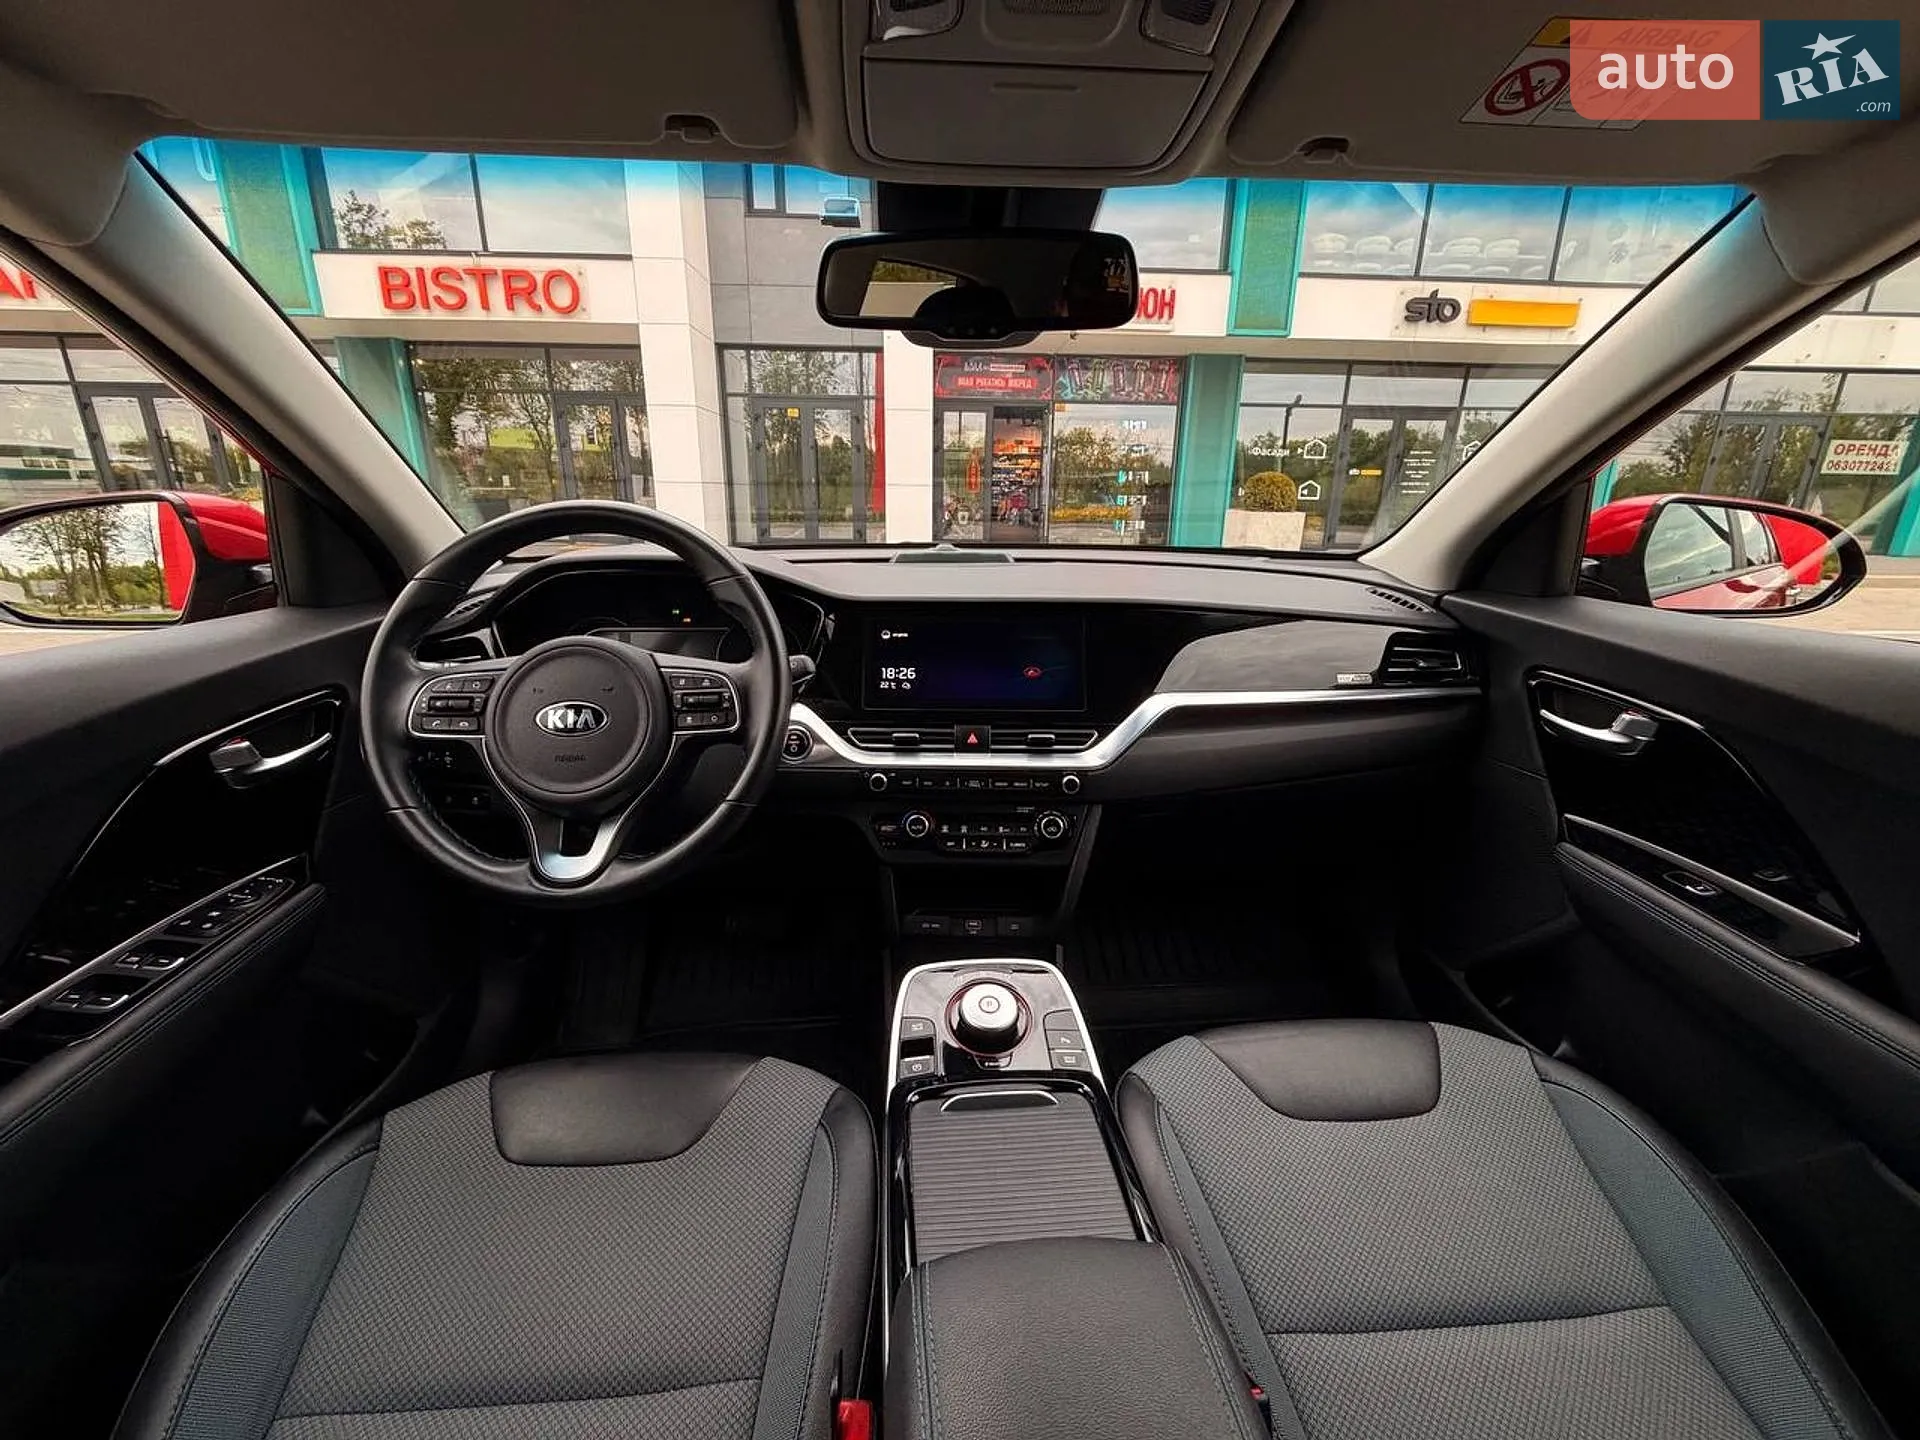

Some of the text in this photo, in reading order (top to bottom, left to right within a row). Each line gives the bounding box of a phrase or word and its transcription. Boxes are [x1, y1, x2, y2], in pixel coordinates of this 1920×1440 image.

[378, 266, 580, 314] BISTRO
[1404, 288, 1462, 323] sto
[1252, 446, 1290, 457] Фасади
[881, 667, 916, 679] 18:26
[547, 709, 597, 729] KIA
